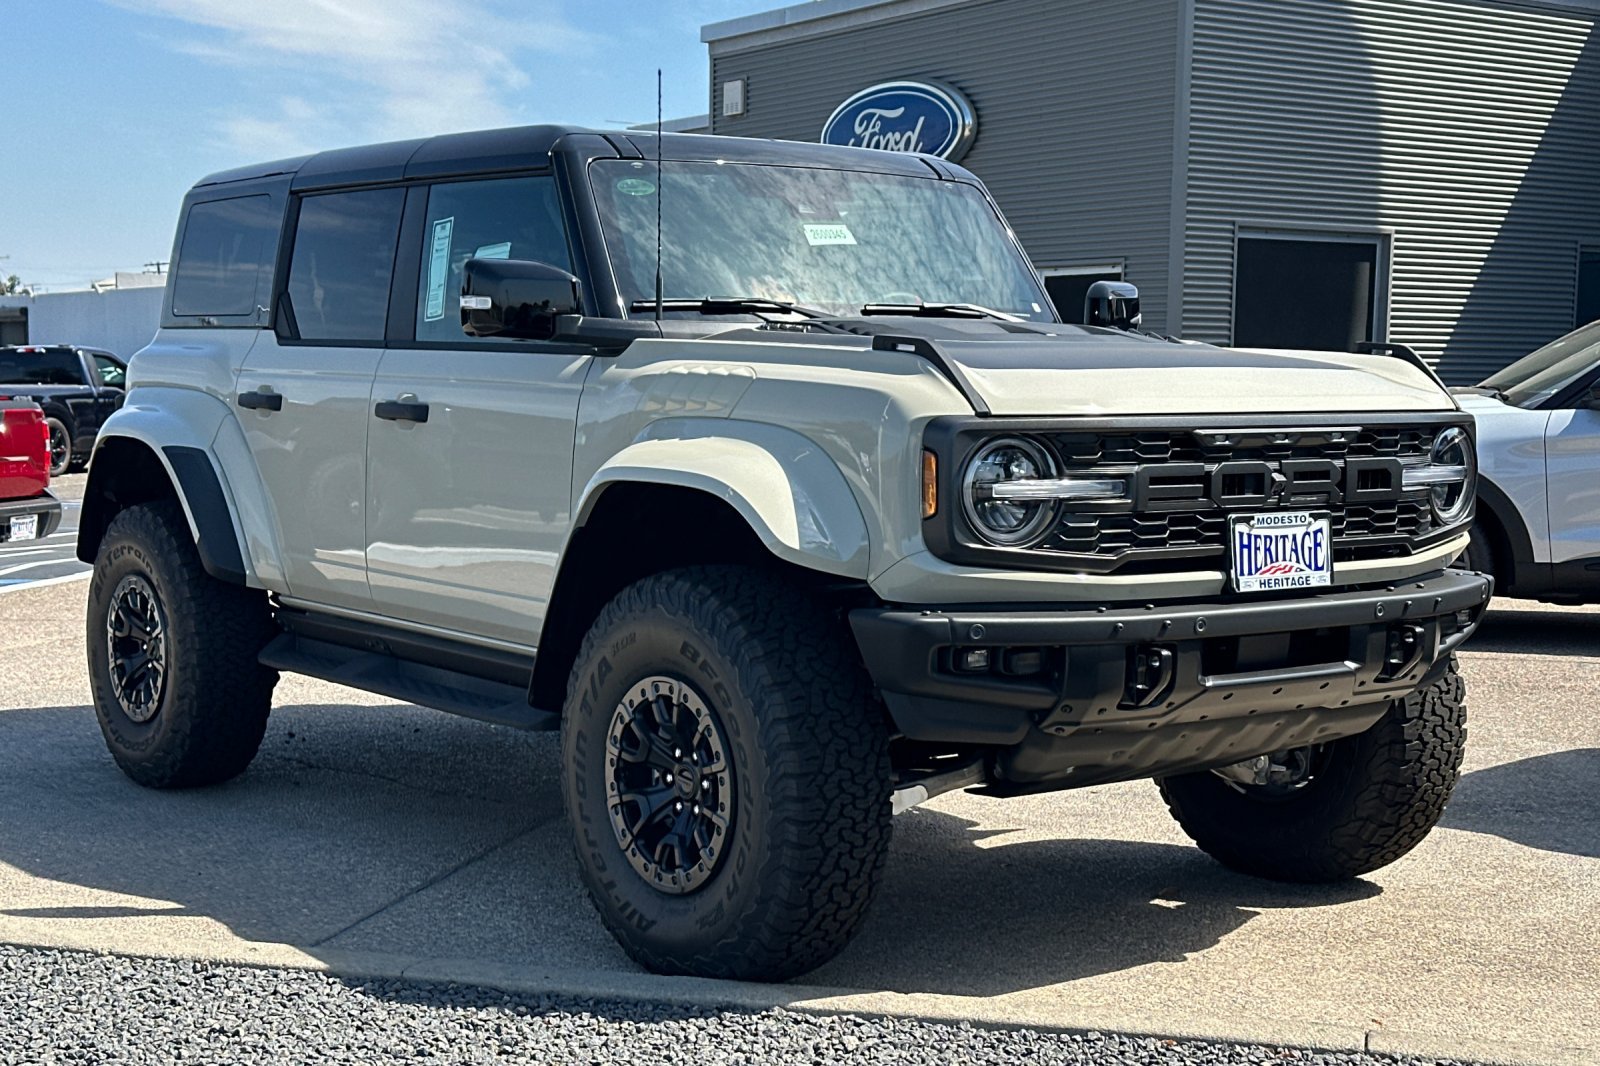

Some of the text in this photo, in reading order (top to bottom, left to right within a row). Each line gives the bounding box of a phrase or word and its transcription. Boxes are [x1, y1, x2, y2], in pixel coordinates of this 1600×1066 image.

[848, 106, 925, 152] Ford
[1137, 457, 1401, 511] FORD
[1256, 515, 1307, 525] MODESTO
[1238, 526, 1326, 577] HERITAGE
[1259, 576, 1312, 589] HERITAGE
